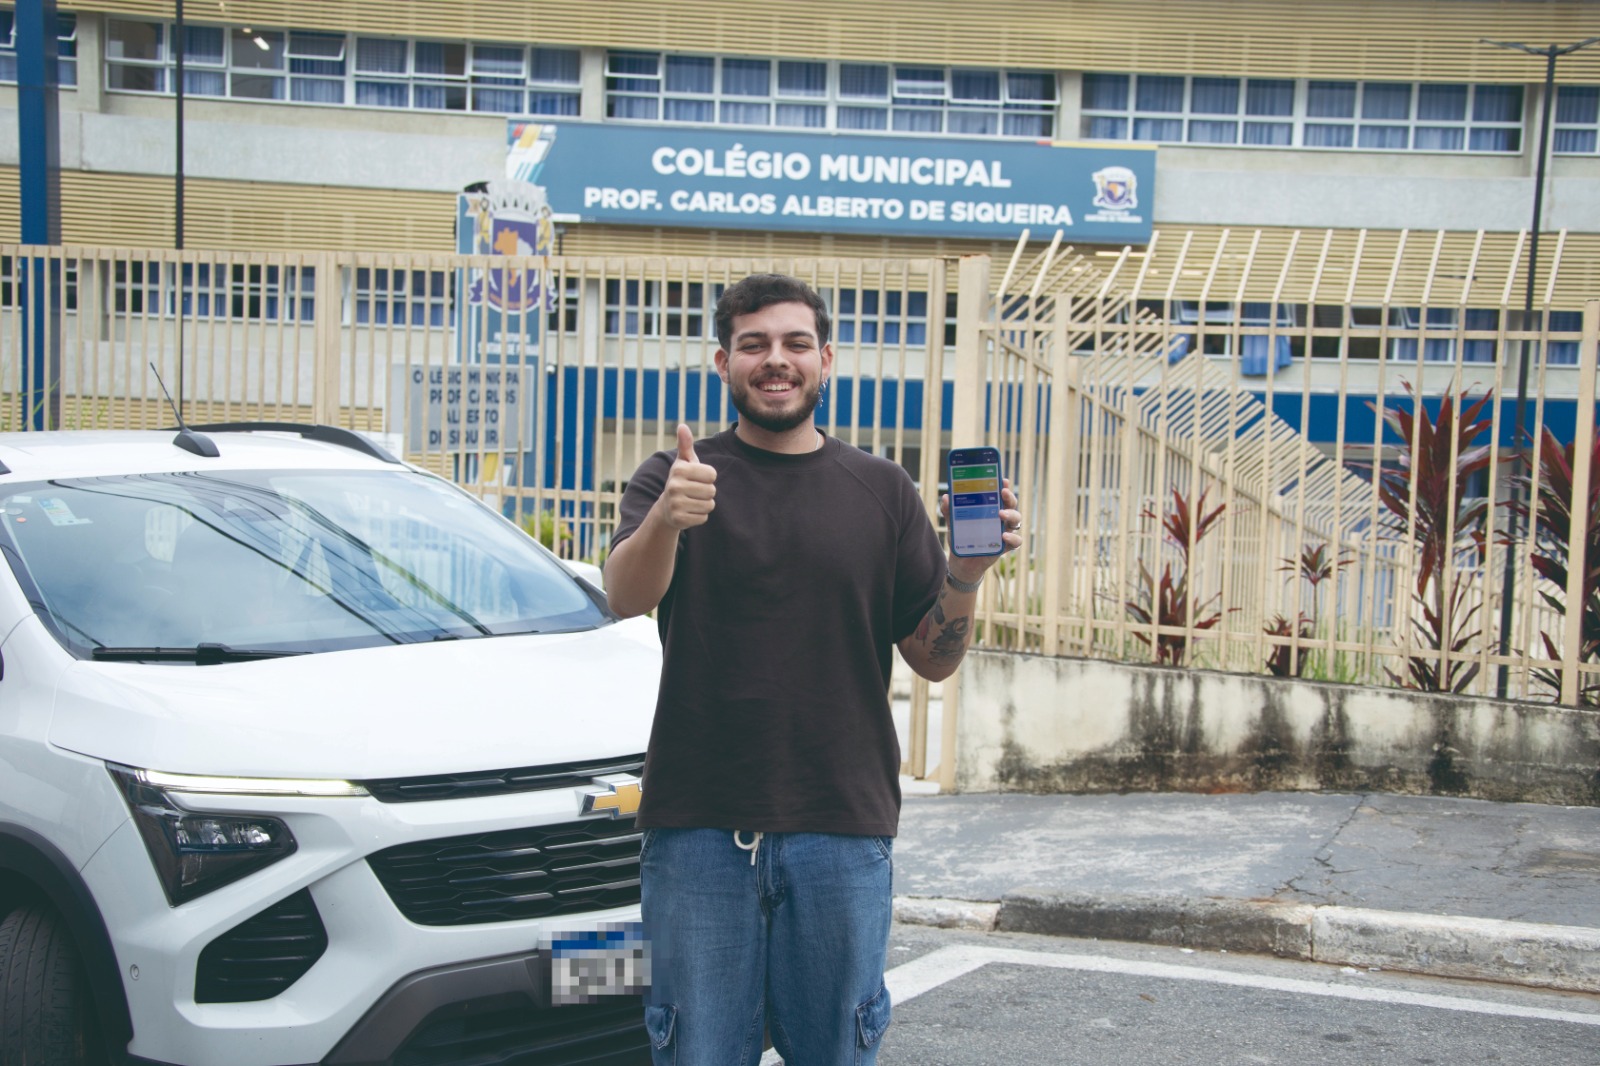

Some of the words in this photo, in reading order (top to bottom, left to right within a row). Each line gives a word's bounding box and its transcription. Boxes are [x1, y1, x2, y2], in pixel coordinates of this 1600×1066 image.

[652, 143, 811, 180] COLÉGIO
[820, 154, 1012, 188] MUNICIPAL
[584, 186, 663, 210] PROF.
[670, 190, 776, 215] CARLOS
[782, 195, 904, 221] ALBERTO
[909, 199, 945, 222] DE
[950, 201, 1074, 227] SIQUEIRA
